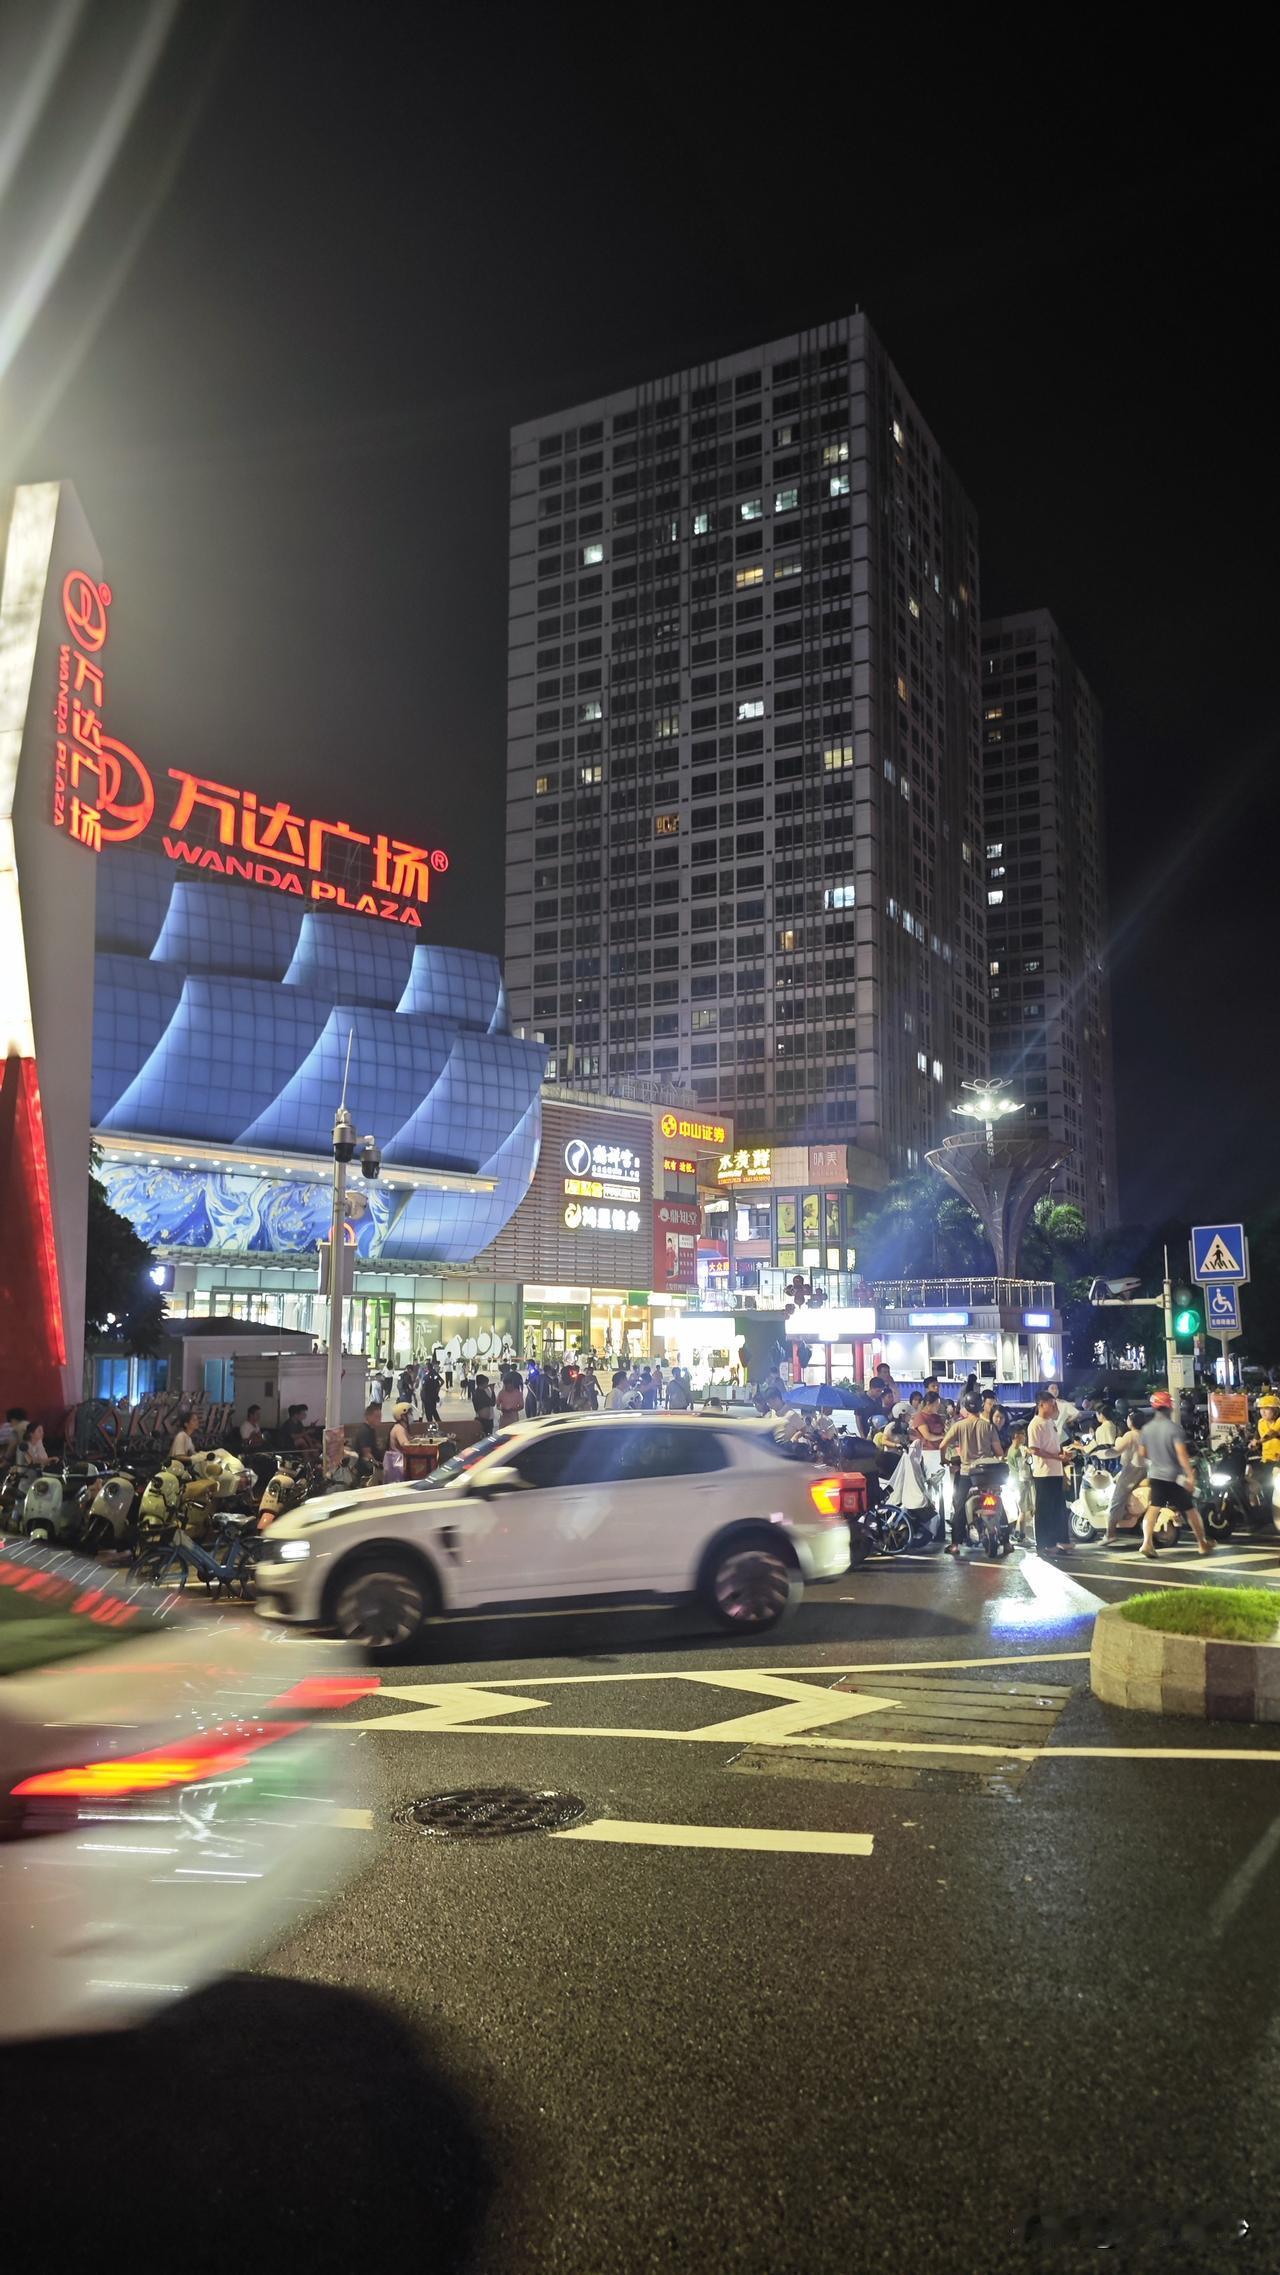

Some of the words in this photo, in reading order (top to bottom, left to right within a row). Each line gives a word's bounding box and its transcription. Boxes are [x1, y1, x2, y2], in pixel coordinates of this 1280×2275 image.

[56, 643, 71, 735] WANDA
[53, 739, 68, 827] PLAZA
[69, 650, 104, 853] 万达广场
[167, 767, 429, 904] 万达广场
[162, 836, 304, 896] WANDA
[311, 879, 423, 928] PLAZA
[679, 1121, 726, 1143] 中山证券
